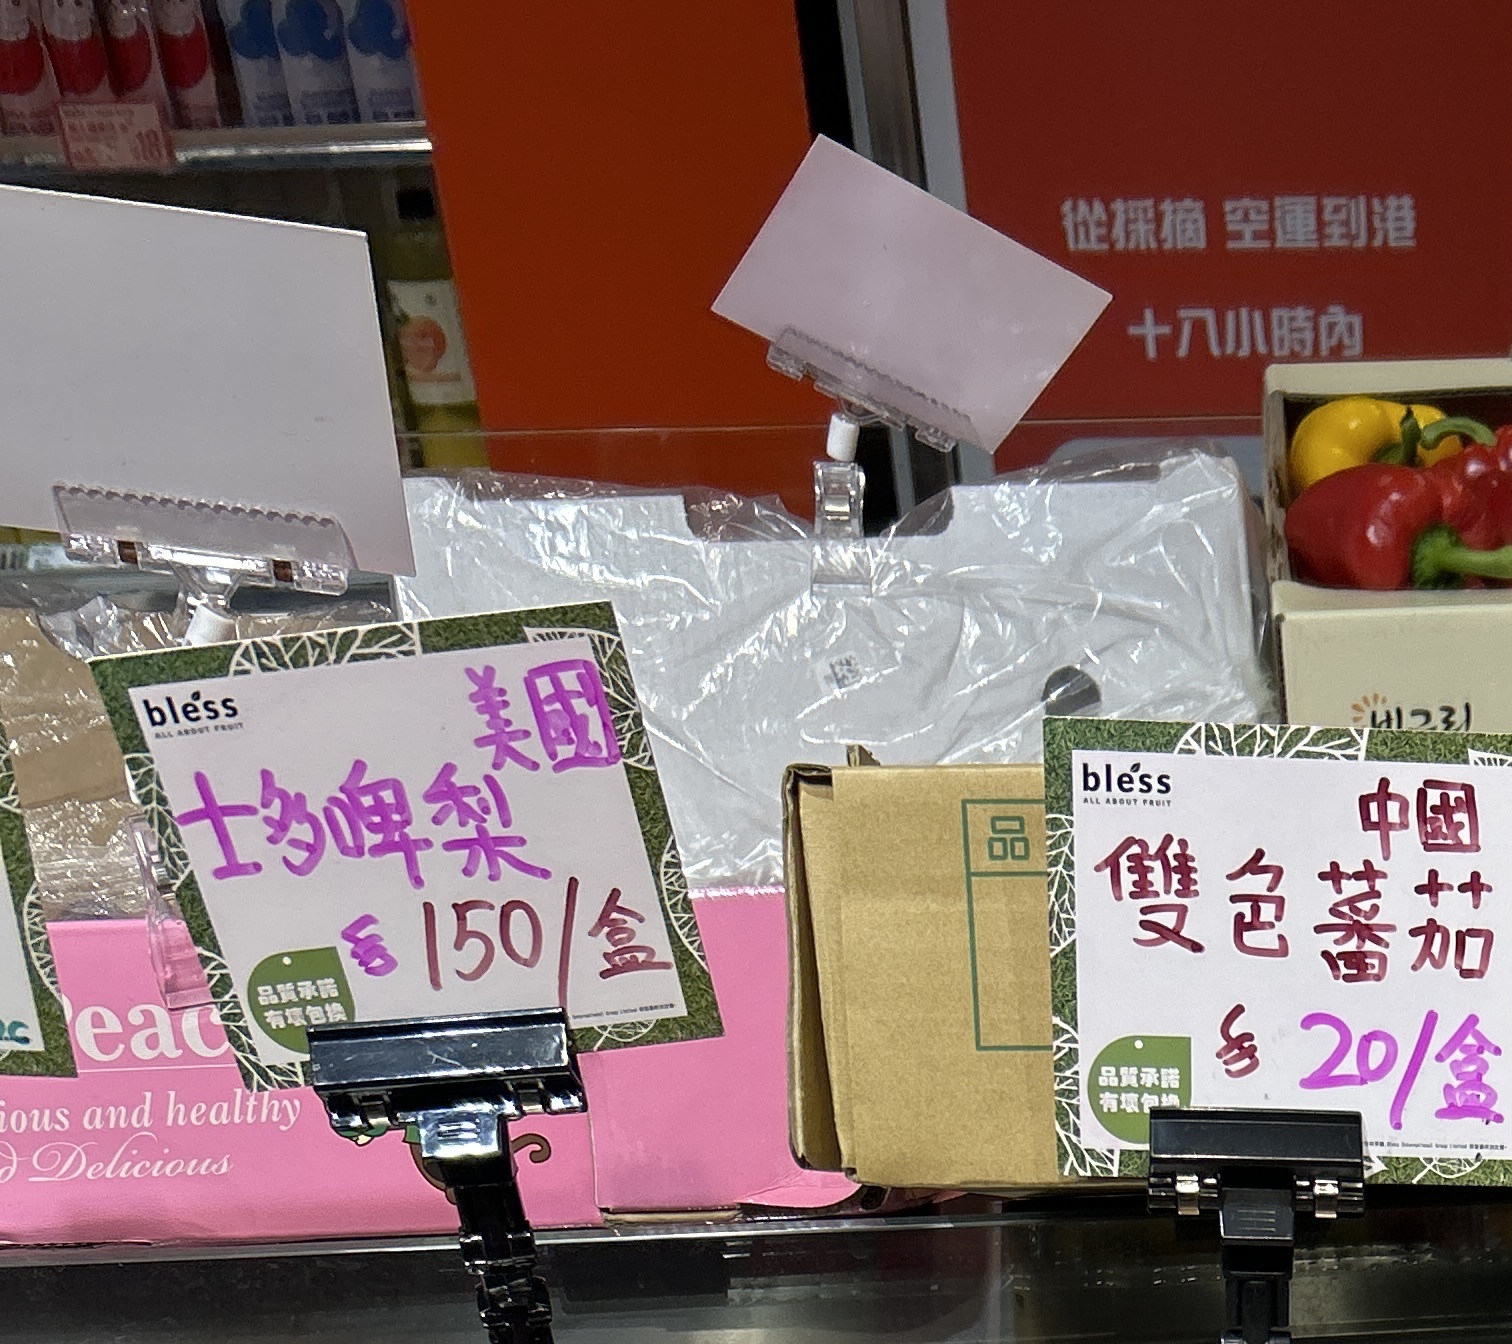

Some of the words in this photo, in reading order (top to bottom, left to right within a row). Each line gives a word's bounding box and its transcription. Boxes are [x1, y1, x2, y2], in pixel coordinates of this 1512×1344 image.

[1061, 197, 1208, 252] 從採摘
[1224, 194, 1416, 250] 空運到港
[1128, 304, 1363, 359] 十八小時內
[142, 690, 238, 726] bless
[155, 731, 173, 739] ALL
[177, 726, 210, 736] ABOUT
[214, 722, 243, 732] FRUIT
[464, 656, 622, 776] 美國
[1082, 762, 1172, 794] bless
[1083, 797, 1101, 805] ALL
[1105, 797, 1138, 806] ABOUT
[1142, 798, 1172, 807] FRUIT
[175, 759, 553, 888] 士多啤梨
[987, 815, 1030, 861] 品
[1357, 775, 1481, 861] 中國
[62, 994, 232, 1062] eac
[1300, 1008, 1505, 1130] 20/盒
[83, 1091, 153, 1130] and
[166, 1089, 300, 1131] healthy
[28, 1131, 232, 1182] Delicious
